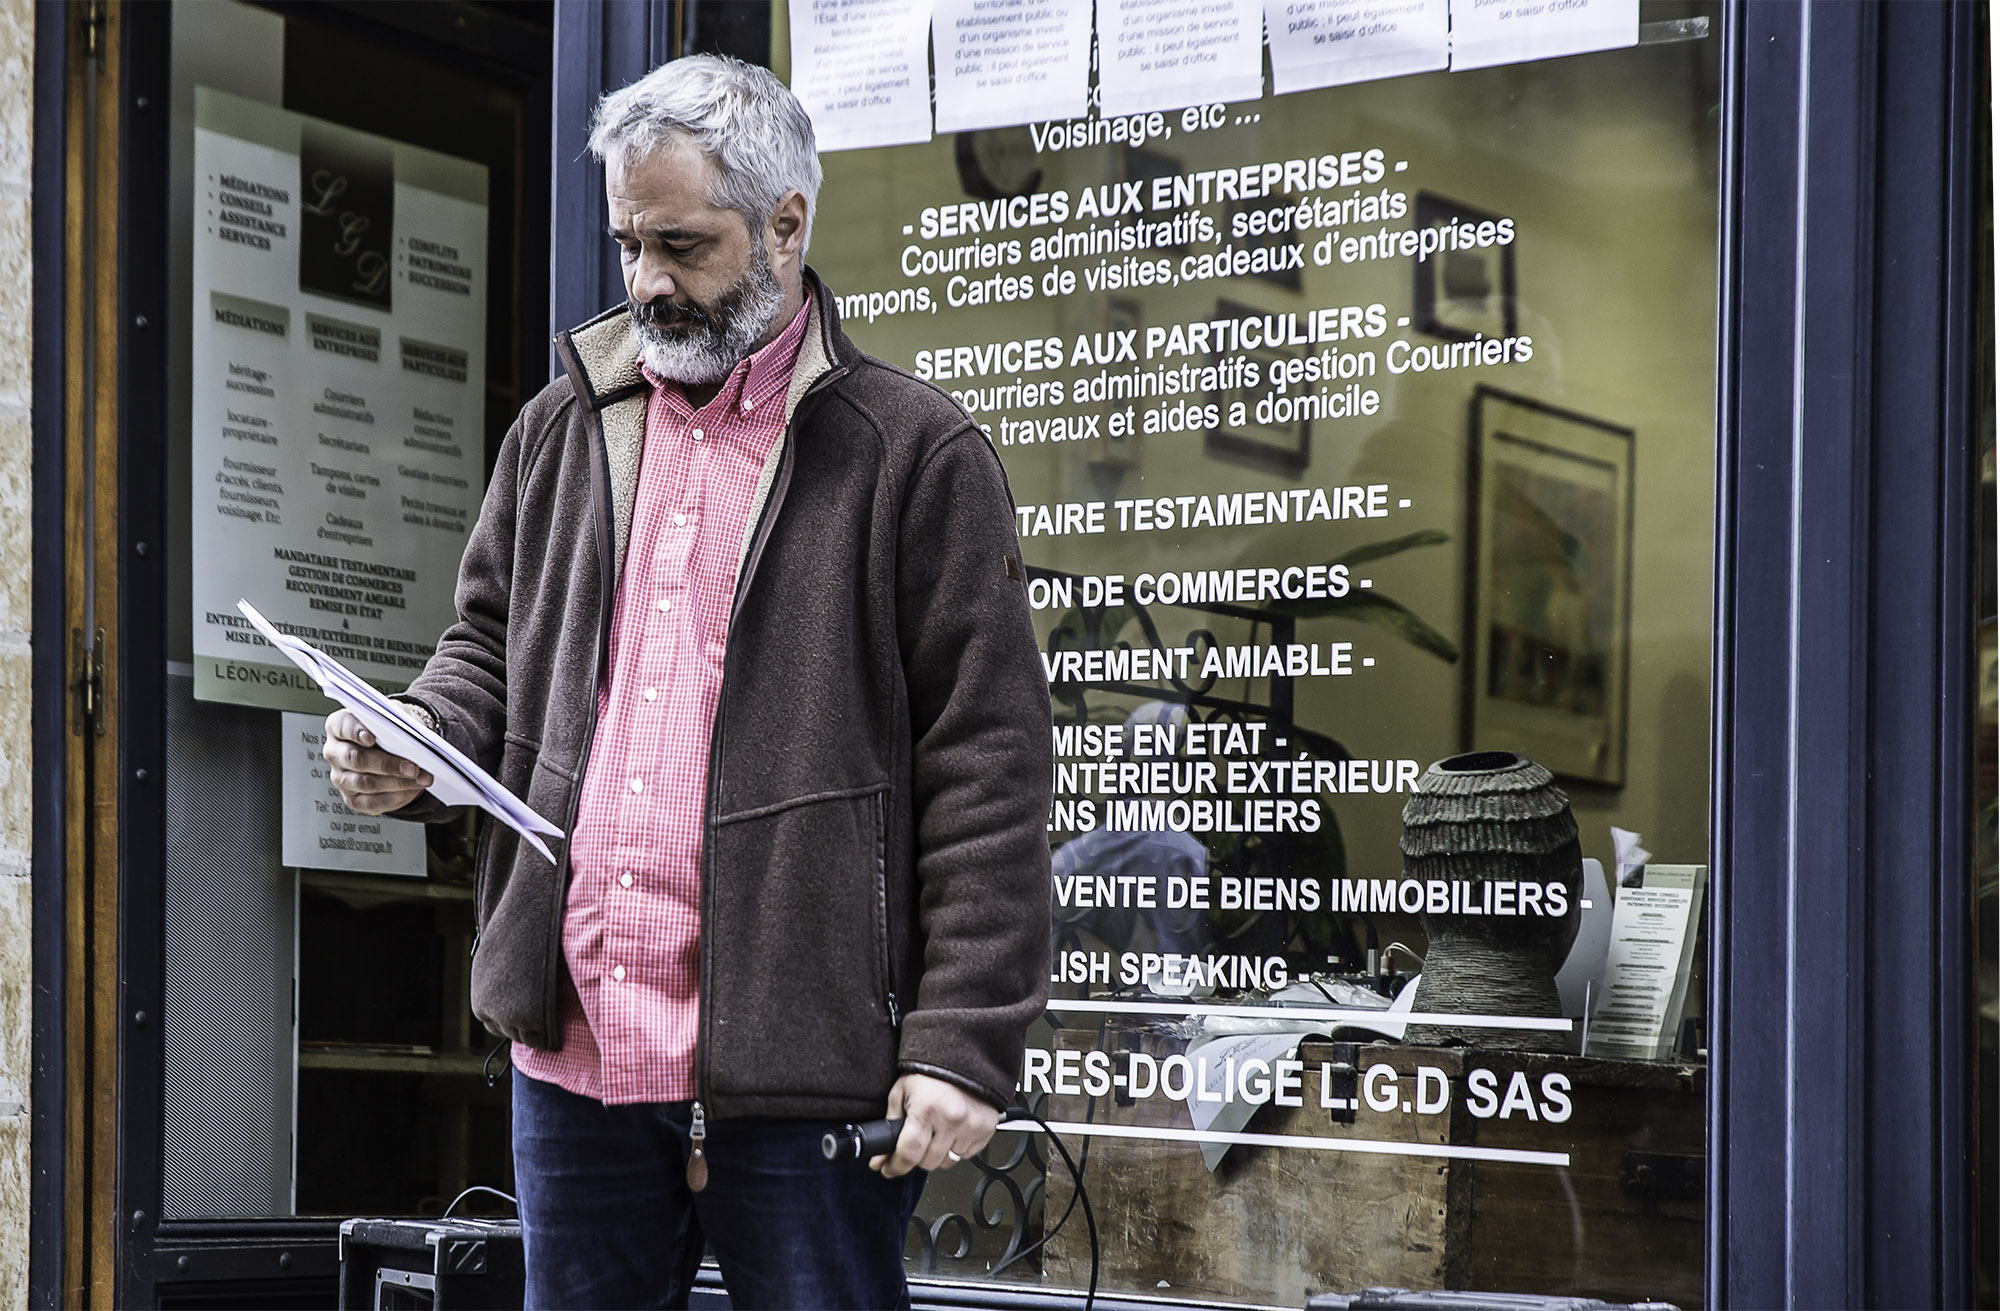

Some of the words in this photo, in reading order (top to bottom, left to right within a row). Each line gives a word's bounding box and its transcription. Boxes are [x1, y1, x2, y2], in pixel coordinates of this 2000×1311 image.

[956, 11, 1023, 29] établissement
[1025, 8, 1053, 24] public
[1123, 13, 1144, 26] d'un
[1146, 6, 1199, 24] organisme
[1201, 1, 1235, 14] investi
[1287, 0, 1316, 16] d'une
[1500, 9, 1513, 20] se
[1516, 4, 1545, 18] saisir
[1549, 0, 1589, 13] d'office
[959, 30, 980, 44] d'un
[982, 26, 1033, 43] organisme
[1118, 29, 1145, 44] d'une
[1147, 24, 1185, 39] mission
[1187, 21, 1200, 33] de
[1203, 16, 1240, 31] service
[1288, 17, 1320, 35] public
[1336, 10, 1361, 27] peut
[1313, 33, 1326, 45] se
[1329, 28, 1356, 42] saisir
[1359, 21, 1398, 38] d'office
[955, 46, 981, 60] d'une
[984, 42, 1021, 57] mission
[1118, 44, 1146, 61] public
[1163, 39, 1184, 55] peut
[1187, 32, 1240, 51] également
[955, 61, 983, 78] public
[1140, 62, 1151, 72] se
[1154, 56, 1180, 70] saisir
[1182, 51, 1218, 66] d'office
[1029, 111, 1173, 154] Voisinage,
[1181, 102, 1227, 133] etc
[219, 171, 291, 206] MÉDIATIONS
[919, 190, 1070, 241] SERVICES
[1075, 180, 1144, 220] AUX
[1152, 148, 1386, 212] ENTREPRISES
[219, 190, 274, 218] CONSEILS
[219, 208, 288, 240] ASSISTANCE
[901, 238, 1022, 278] Courriers
[1030, 210, 1222, 266] administratifs,
[1231, 187, 1409, 239] secrétariats
[219, 226, 272, 252] SERVICES
[408, 236, 459, 262] CONFLITS
[408, 252, 473, 282] PATRIMOINE
[834, 286, 938, 325] ampons,
[946, 272, 1034, 309] Cartes
[1042, 264, 1077, 297] de
[1313, 216, 1516, 267] d'entreprises
[408, 269, 472, 297] SUCCESSION
[214, 306, 286, 339] MÉDIATIONS
[311, 321, 357, 345] SERVICES
[358, 331, 381, 348] AUX
[313, 336, 380, 363] ENTREPRISES
[914, 336, 1065, 382] SERVICES
[1070, 328, 1138, 368] AUX
[1145, 303, 1388, 360] PARTICULIERS
[402, 357, 468, 384] PARTICULIERS
[1072, 355, 1261, 403] administratifs
[1269, 347, 1377, 395] gestion
[1386, 332, 1535, 376] Courriers
[225, 378, 276, 399] succession
[1001, 415, 1100, 446] travaux
[1108, 404, 1136, 438] et
[1143, 398, 1220, 434] aides
[1228, 400, 1247, 428] a
[1255, 383, 1381, 425] domicile
[222, 425, 279, 448] propriétaire
[223, 455, 277, 477] fournisseur
[325, 480, 338, 494] de
[1016, 500, 1107, 538] TAIRE
[1114, 483, 1390, 533] TESTAMENTAIRE
[317, 526, 374, 548] d'entreprises
[274, 547, 339, 570] MANDATAIRE
[340, 558, 417, 583] TESTAMENTAIRE
[289, 564, 330, 581] GESTION
[331, 570, 346, 584] DE
[346, 575, 403, 594] COMMERCES
[286, 579, 363, 602] RECOUVREMENT
[364, 591, 406, 610] AMIABLE
[1027, 577, 1073, 610] ON
[1082, 574, 1126, 608] DE
[1133, 564, 1351, 606] COMMERCES
[309, 598, 346, 614] REMISE
[347, 603, 361, 617] EN
[362, 606, 383, 620] ETAT
[225, 630, 251, 645] MISE
[253, 633, 268, 647] EN
[324, 643, 355, 661] VENTE
[356, 649, 369, 662] DE
[369, 650, 397, 666] BIENS
[373, 637, 386, 650] DE
[386, 639, 414, 654] BIENS
[214, 660, 323, 692] LÉON-GAILL
[1041, 646, 1195, 683] VREMENT
[1200, 642, 1354, 679] AMIABLE
[301, 731, 319, 745] Nos
[1133, 724, 1176, 757] EN
[1186, 722, 1267, 756] ETAT
[307, 750, 317, 761] le
[1227, 753, 1421, 794] EXTÉRIEUR
[330, 821, 341, 832] ou
[343, 821, 356, 834] par
[358, 822, 381, 835] email
[1105, 798, 1322, 833] IMMOBILIERS
[1053, 874, 1157, 909] VENTE
[1166, 876, 1210, 911] DE
[1219, 877, 1322, 913] BIENS
[1331, 877, 1568, 918] IMMOBILIERS
[1118, 951, 1288, 991] SPEAKING
[1016, 1046, 1304, 1108] RES-DOLIGÉ
[1321, 1061, 1451, 1116] L.G.D
[1466, 1067, 1573, 1124] SAS
